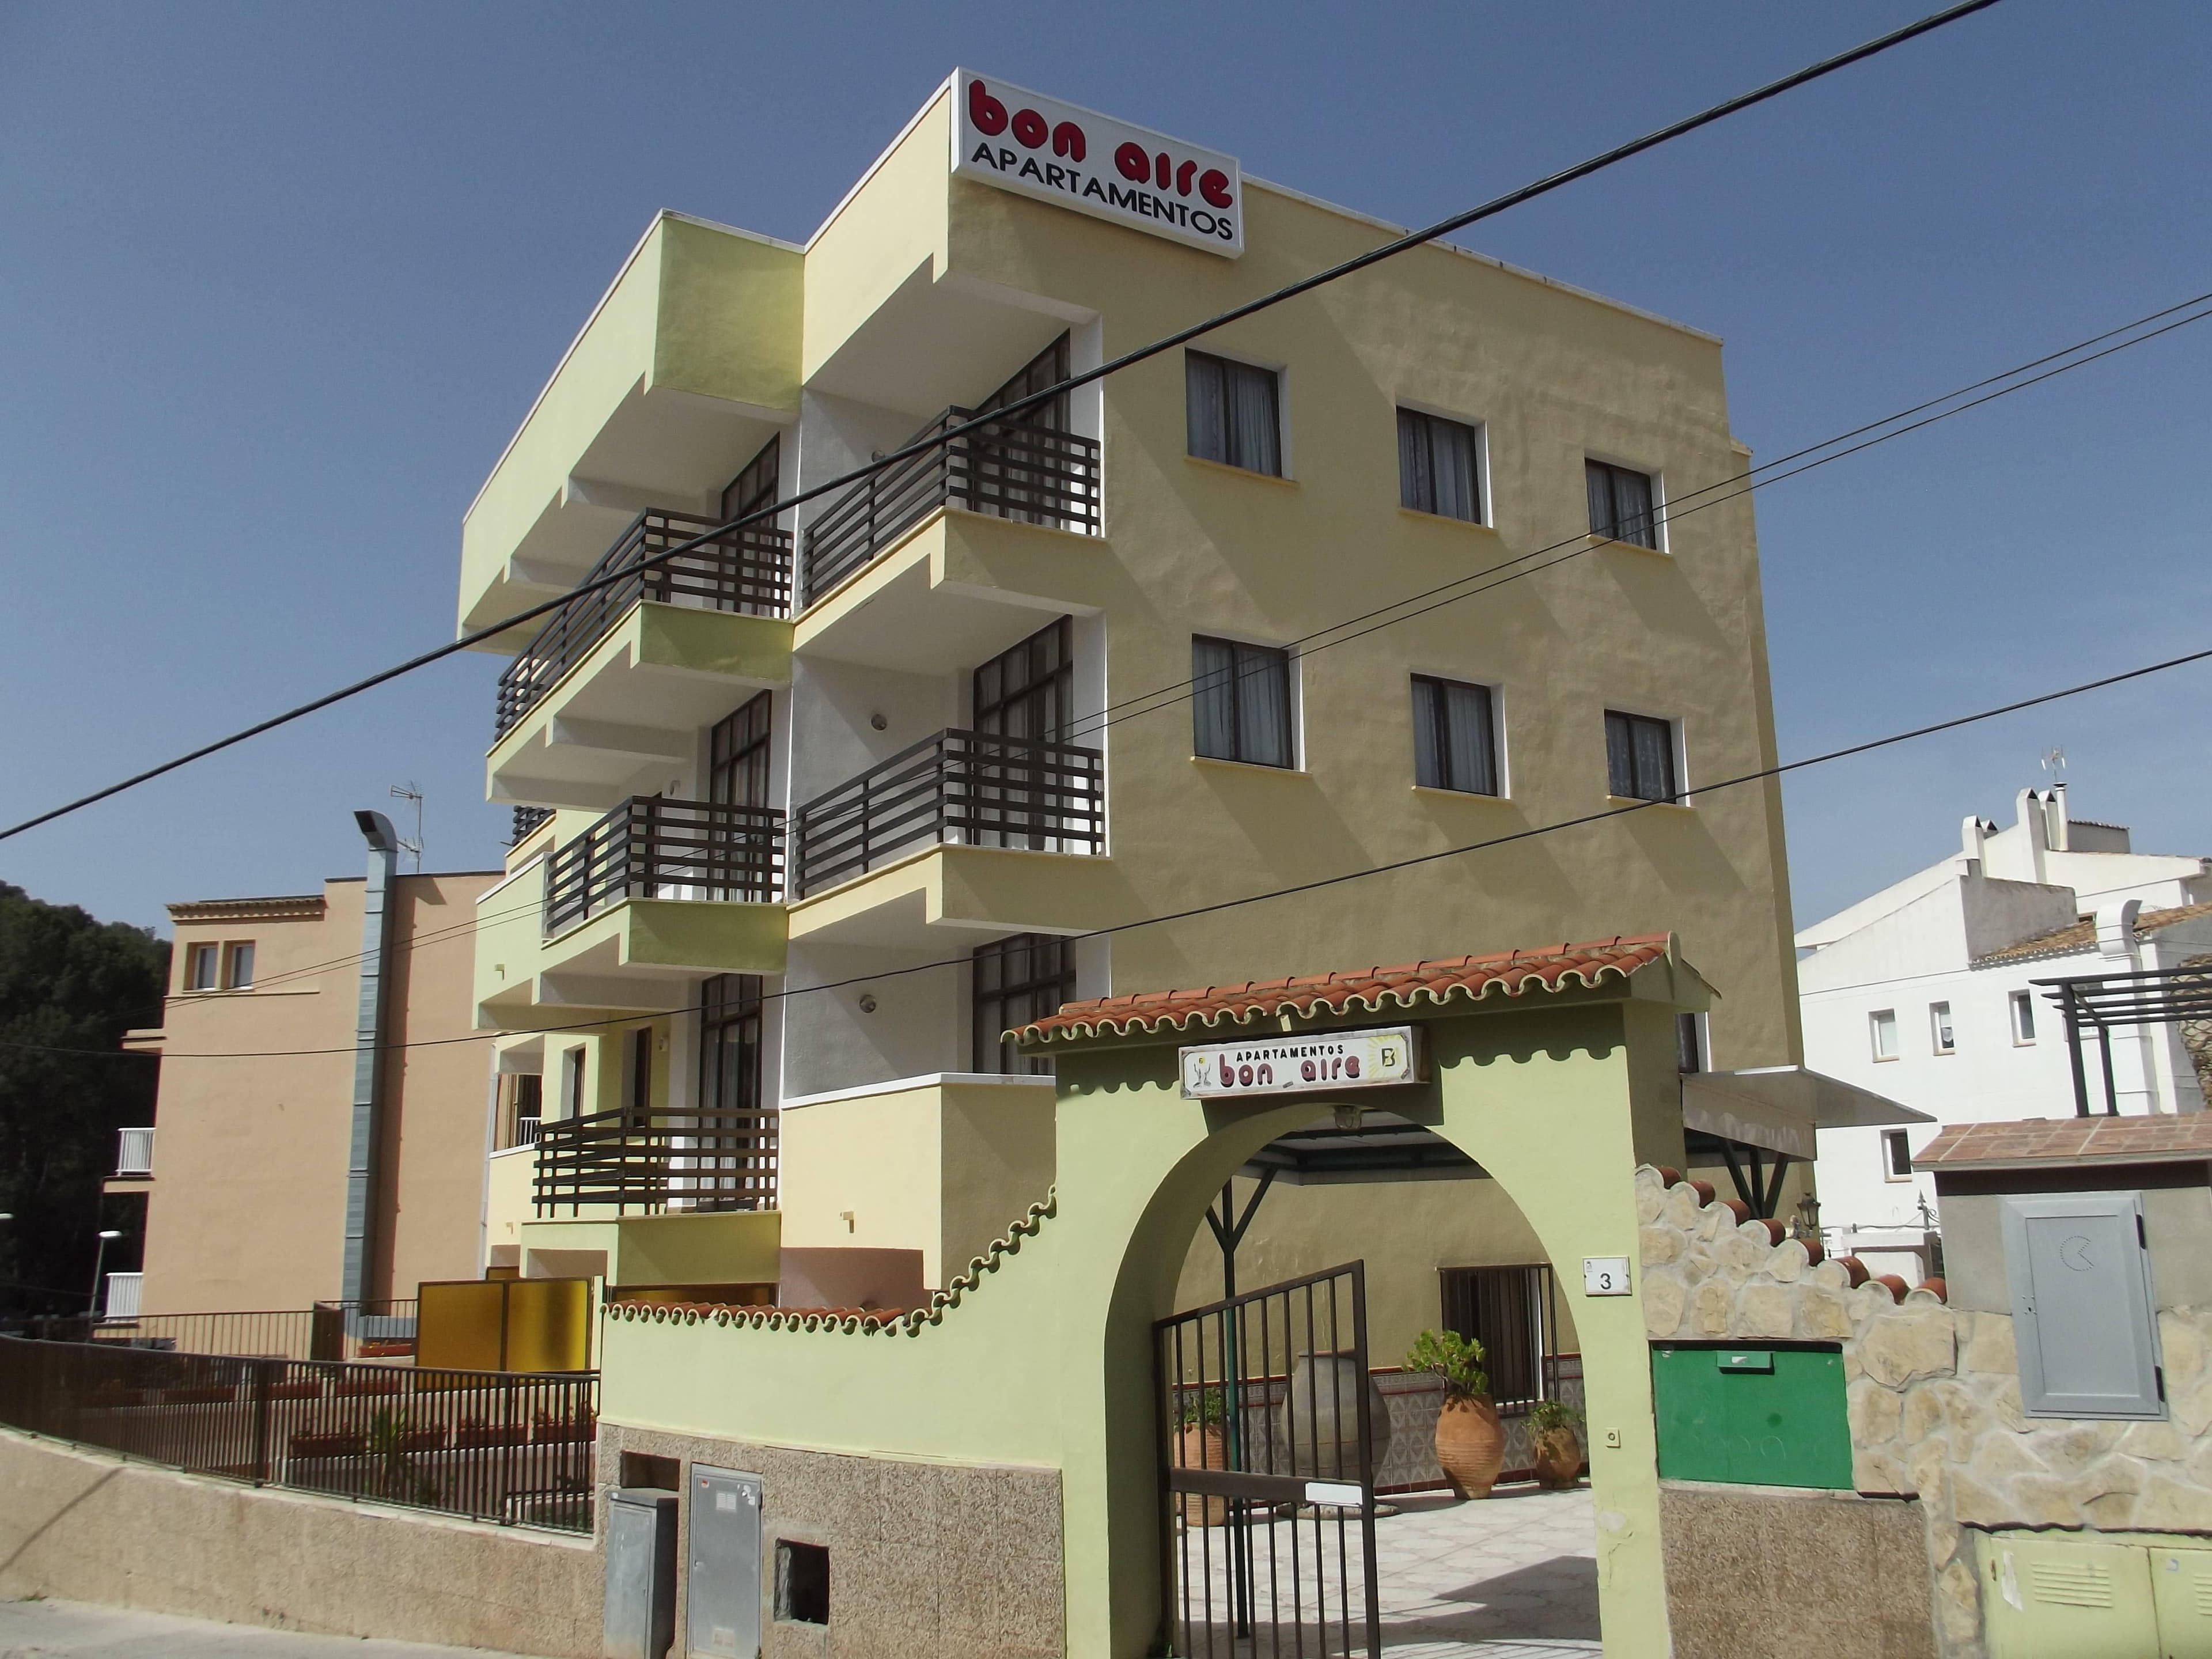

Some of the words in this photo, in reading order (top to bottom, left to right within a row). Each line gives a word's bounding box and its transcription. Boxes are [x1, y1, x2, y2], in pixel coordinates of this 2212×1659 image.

[969, 79, 1086, 163] bon
[1114, 142, 1233, 209] aire
[971, 142, 1233, 240] APARTAMENTOS
[1236, 1044, 1344, 1062] APARTAMENTOS
[1219, 1054, 1273, 1088] bon
[1300, 1055, 1360, 1082] aire
[1600, 1273, 1612, 1290] 3
